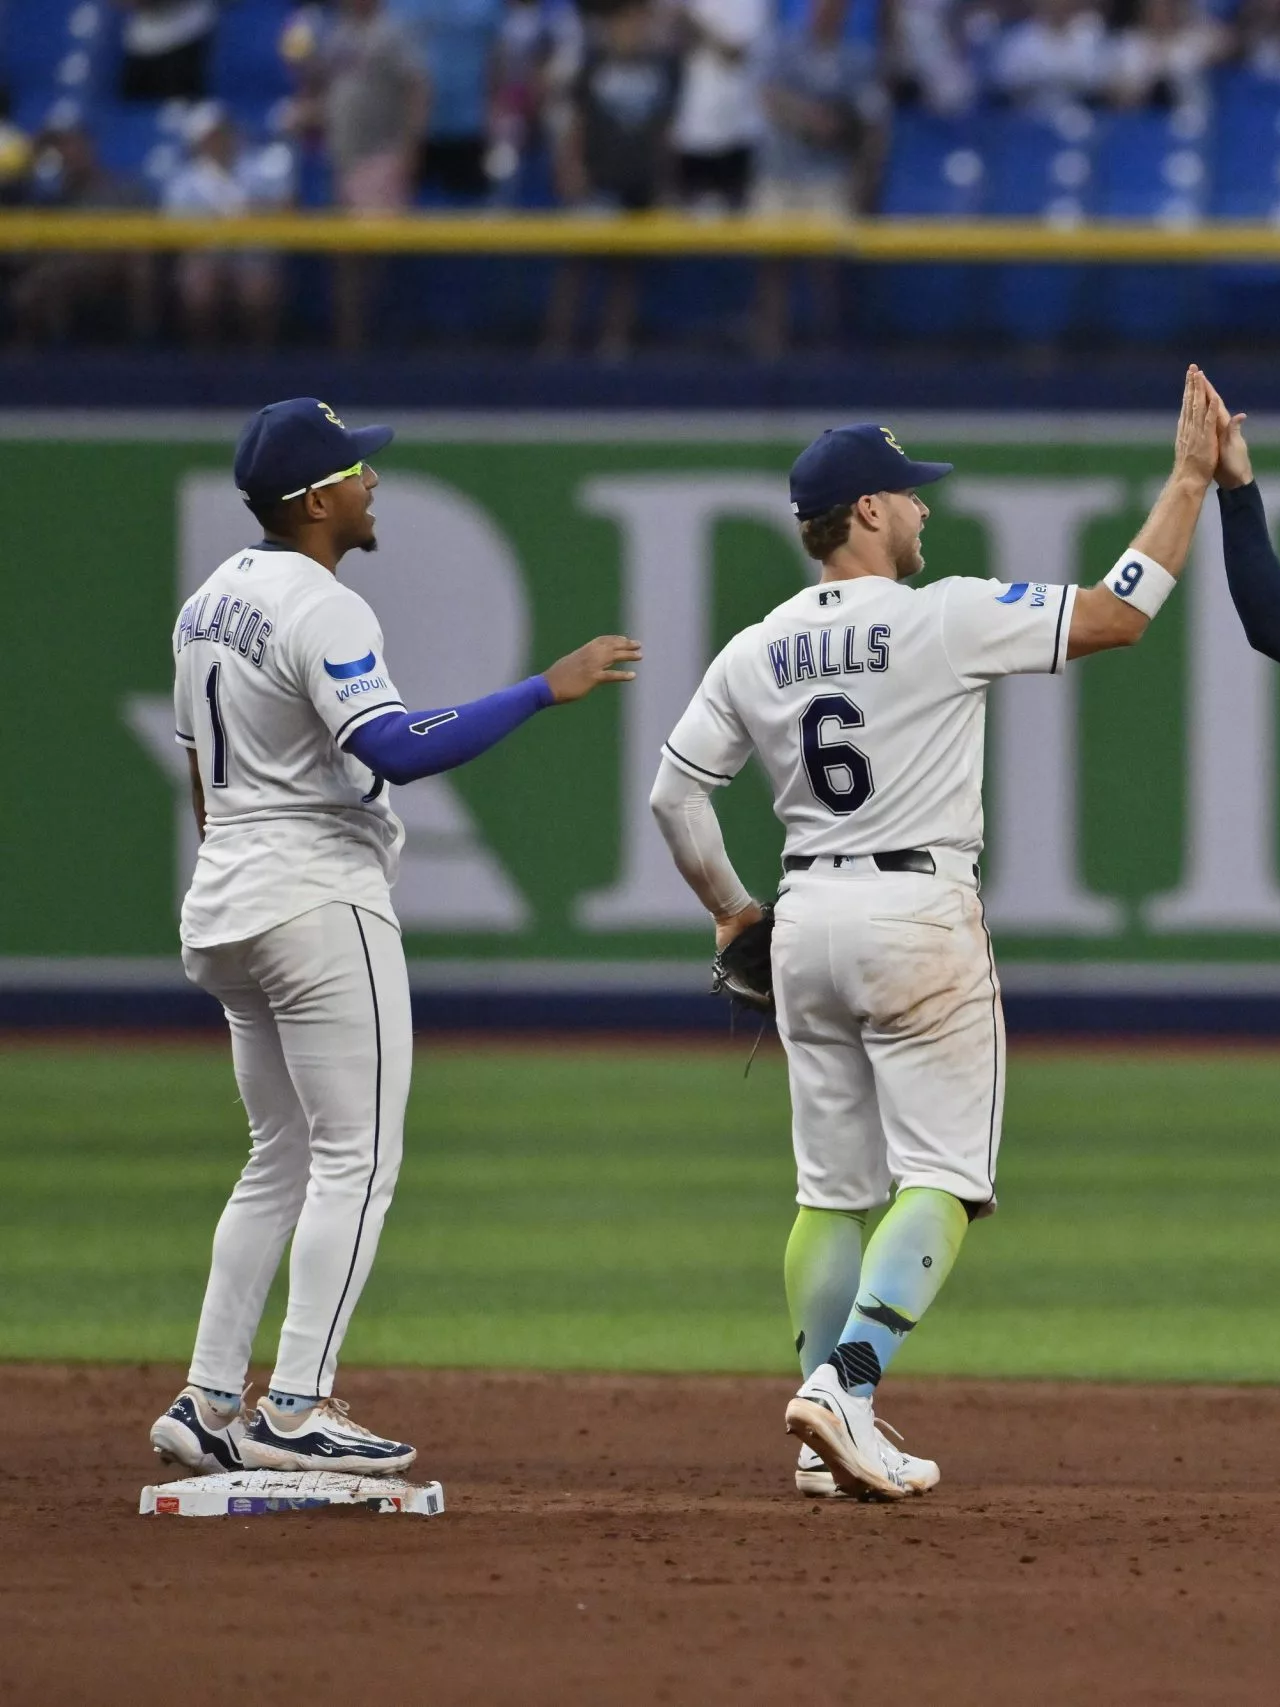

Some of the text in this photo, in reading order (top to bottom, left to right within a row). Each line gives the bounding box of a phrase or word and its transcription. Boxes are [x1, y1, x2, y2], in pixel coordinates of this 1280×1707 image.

[1114, 561, 1144, 597] 9
[767, 623, 891, 689] WALLS
[206, 661, 228, 789] 1
[410, 709, 459, 736] 1
[798, 692, 875, 816] 6
